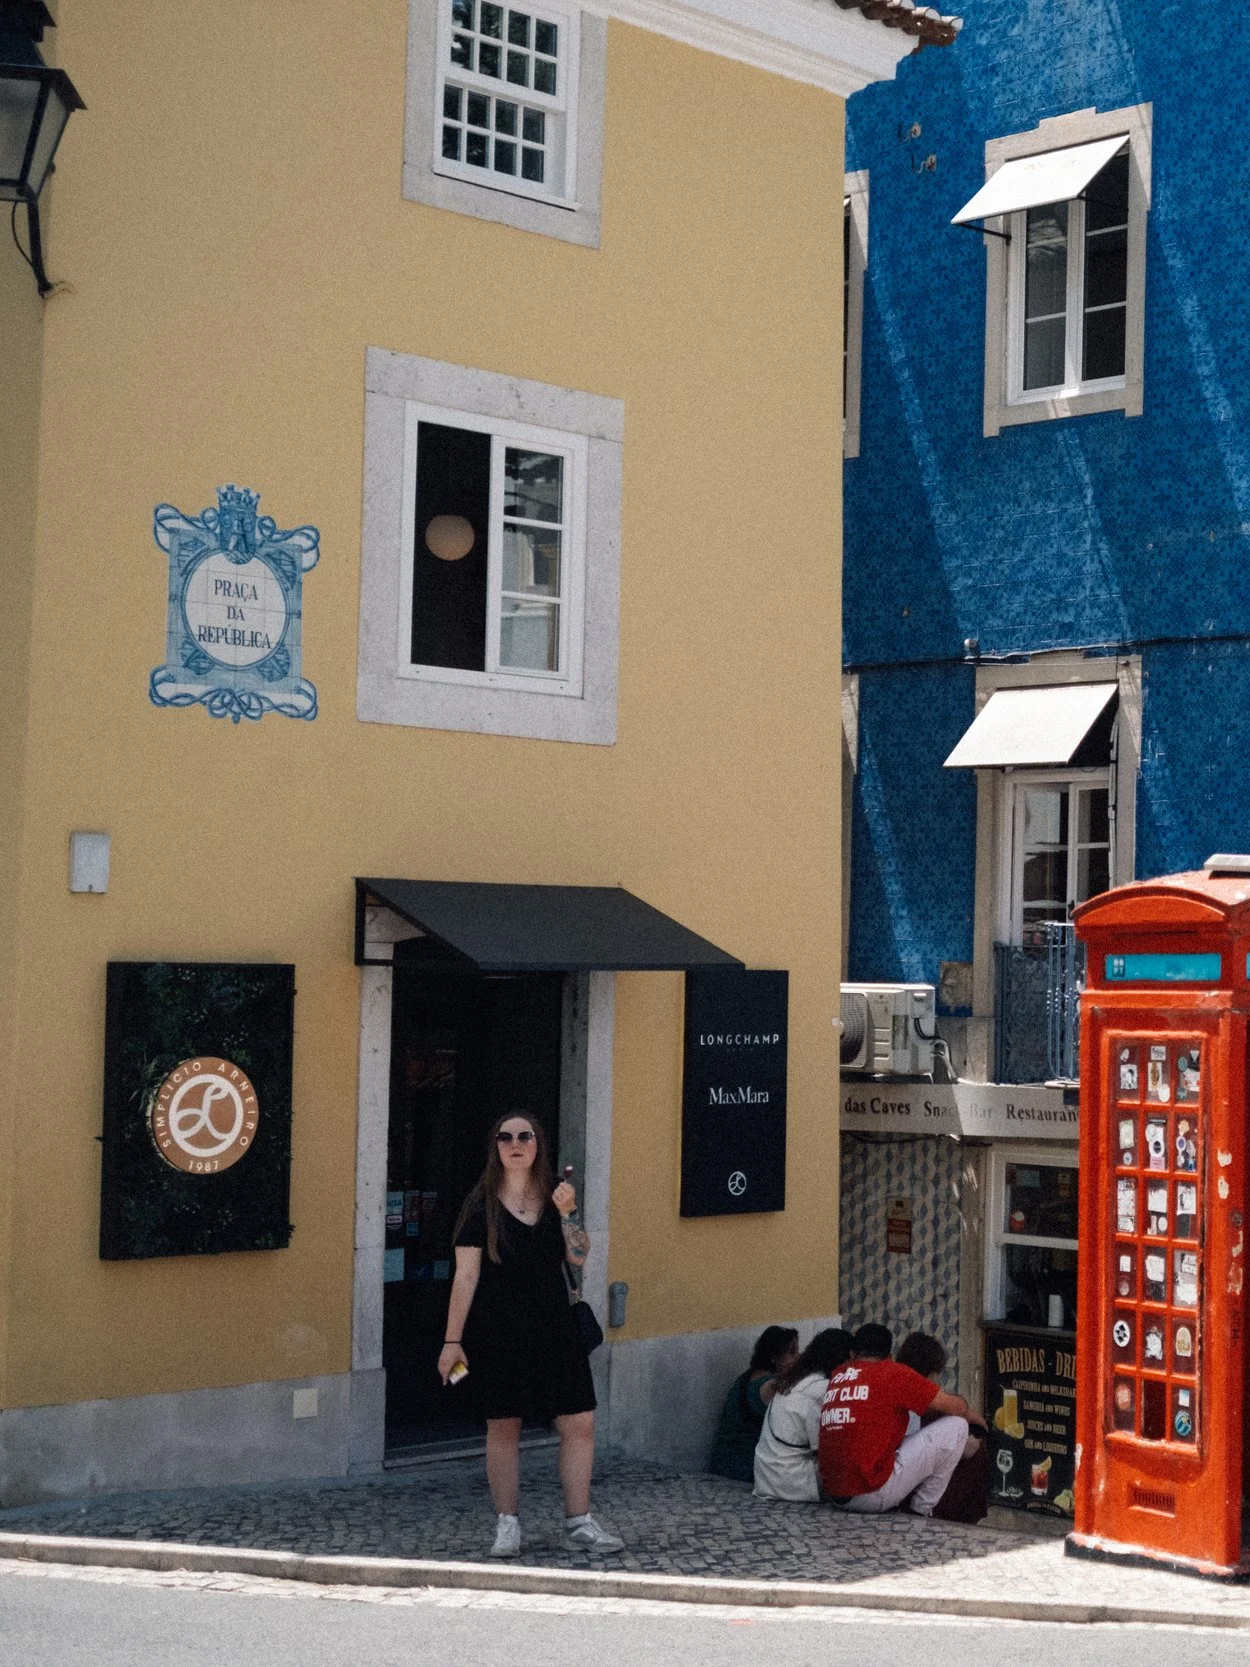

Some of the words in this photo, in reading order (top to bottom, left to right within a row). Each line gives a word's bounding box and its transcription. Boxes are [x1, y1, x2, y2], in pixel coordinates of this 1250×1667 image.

[214, 579, 259, 601] PRAÇA
[227, 605, 245, 621] DA
[700, 1033, 780, 1046] LONGCHAMP
[156, 1061, 202, 1148] SIMPLICIO
[217, 1063, 255, 1147] ARNEIRO
[709, 1086, 770, 1105] MaxMara
[844, 1097, 866, 1114] das
[870, 1097, 911, 1115] Caves
[970, 1102, 994, 1119] Bar
[1006, 1103, 1078, 1122] Restauran
[188, 1160, 220, 1172] 1987
[996, 1347, 1045, 1373] BEBIDAS
[840, 1385, 869, 1402] CLUB
